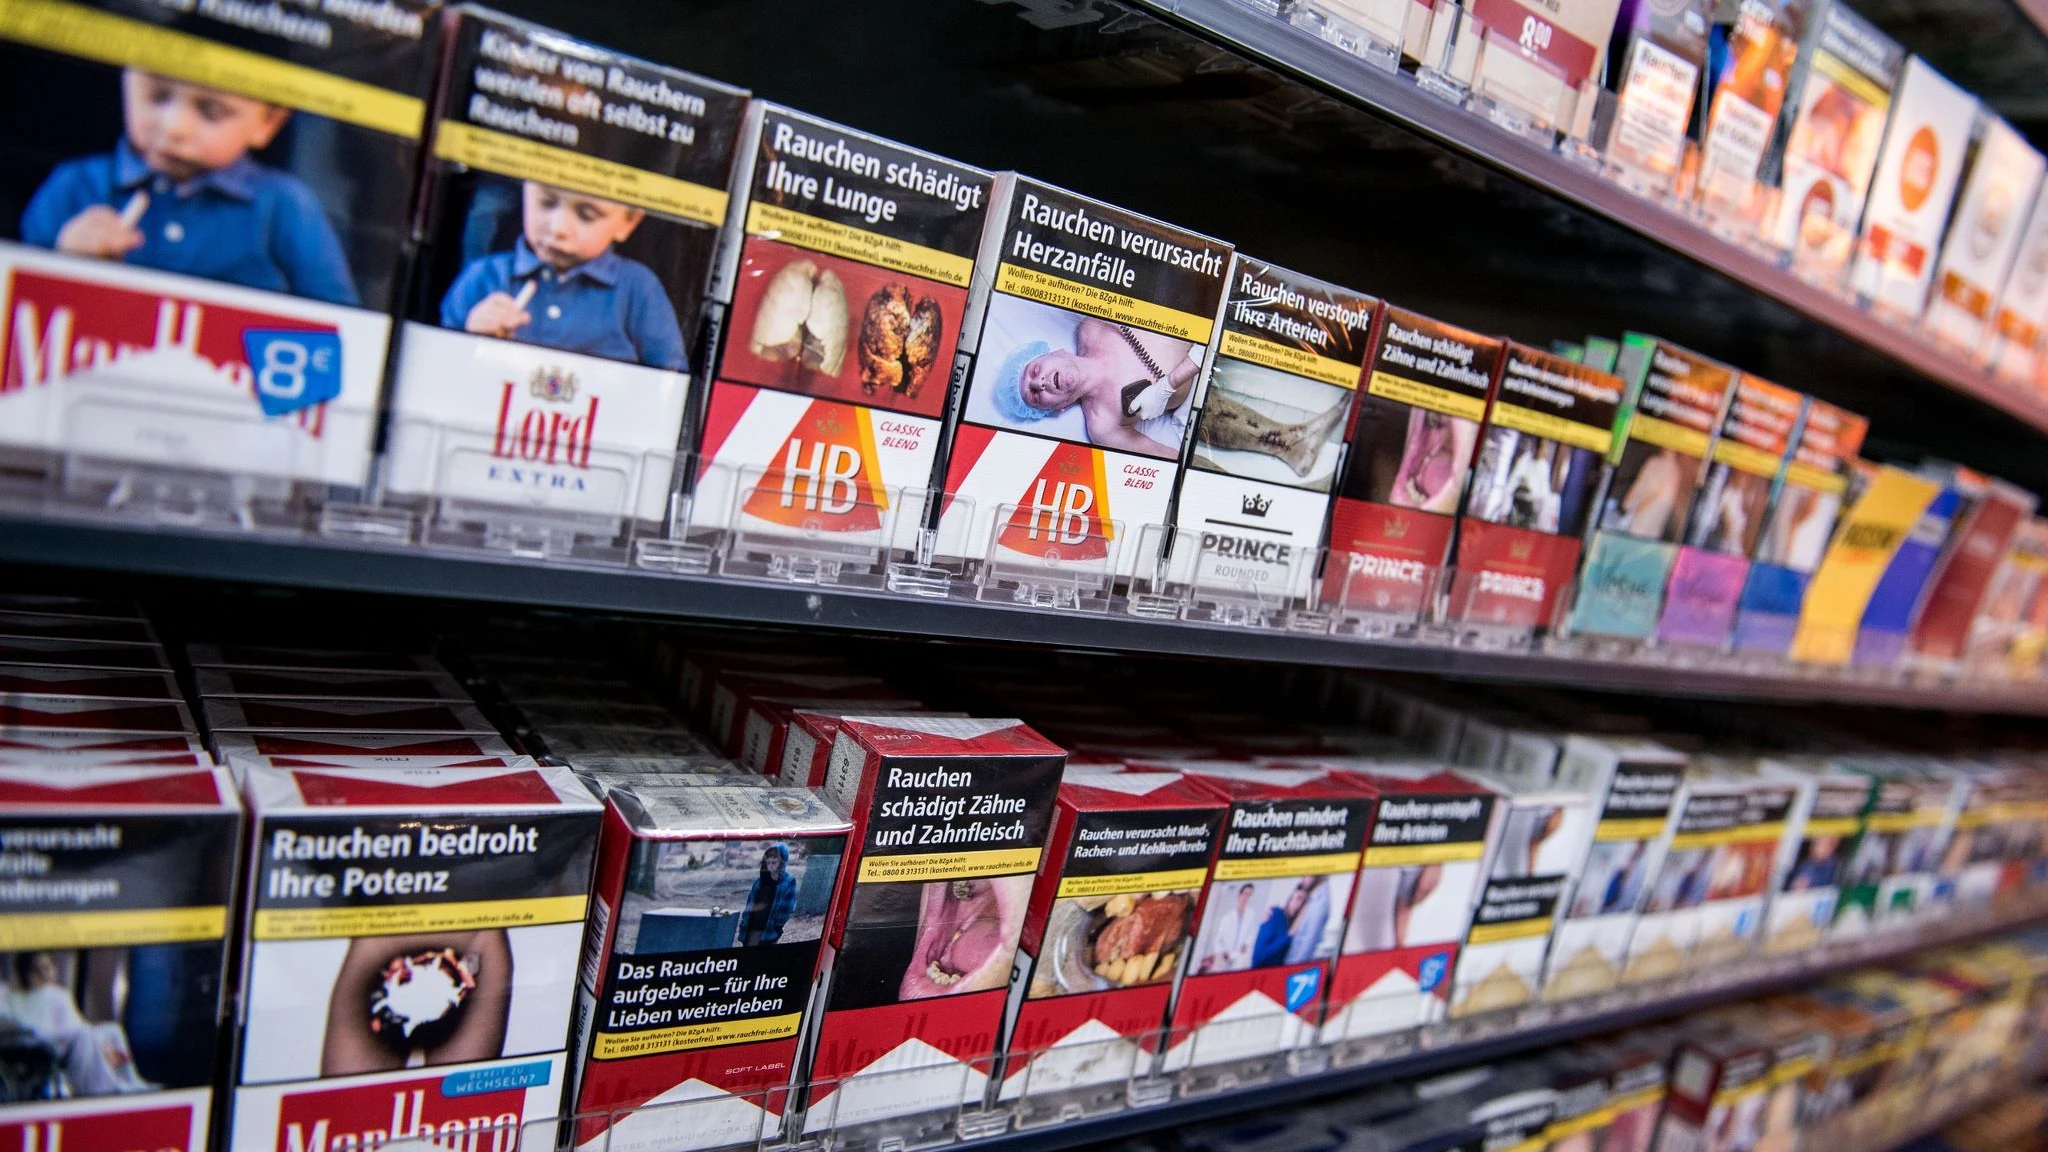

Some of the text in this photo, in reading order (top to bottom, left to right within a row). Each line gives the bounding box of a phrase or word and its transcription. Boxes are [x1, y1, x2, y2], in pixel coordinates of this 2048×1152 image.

[562, 58, 604, 88] von
[607, 68, 706, 116] Rauchern
[469, 94, 579, 145] Rauchern
[474, 66, 696, 145] werden oft selbst zu
[774, 123, 881, 179] Rauchen
[886, 162, 983, 211] schädigt
[766, 161, 897, 223] Ihre Lunge
[1021, 193, 1223, 278] Rauchen verursacht
[882, 256, 963, 282] www.rauchfrei-info.de
[1012, 231, 1136, 288] Herzanfälle
[1007, 266, 1135, 308] Wollen Sie aufhören? Die BZgA hilft:
[1240, 272, 1370, 331] Rauchen verstopft
[1004, 280, 1189, 337] Tel.: 08008313131 (kostenfrei), www.rauchfrei-info.de
[1234, 301, 1328, 347] Ihre Arterien
[1387, 322, 1474, 366] Rauchen schädigt
[1381, 343, 1415, 367] Zähne
[1415, 353, 1436, 372] und
[1436, 359, 1490, 389] Zahnfleisch
[491, 380, 599, 470] Lord
[880, 421, 926, 437] CLASSIC
[882, 437, 919, 451] BLEND
[488, 467, 587, 491] EXTRA
[780, 438, 861, 514] HB
[1123, 464, 1159, 478] CLASSIC
[1125, 478, 1153, 490] BLEND
[1029, 478, 1094, 545] HB
[1201, 532, 1291, 567] PRINCE
[1214, 564, 1270, 582] ROUNDED
[1349, 551, 1425, 583] PRINCE
[887, 766, 972, 788] Rauchen
[881, 795, 1026, 820] schädigt Zähne
[1232, 806, 1348, 828] Rauchen mindert
[272, 824, 538, 861] Rauchen bedroht
[876, 820, 1024, 846] und Zahnfleisch
[1079, 823, 1211, 841] Rauchen verursacht Mund-,
[1225, 830, 1347, 853] Ihre Fruchtbarkeit
[869, 859, 889, 867] Wollen
[900, 858, 928, 866] aufhören?
[939, 857, 953, 865] BZgA
[954, 856, 967, 864] hilft:
[1074, 840, 1207, 858] Rachen- und Kehlkopfkrebs
[269, 867, 449, 899] Ihre Potenz
[867, 869, 880, 877] Tel.:
[906, 867, 928, 875] 313131
[930, 864, 967, 875] (kostenfrei),
[968, 861, 1033, 872] www.rauchfrei-info.de
[618, 956, 738, 980] Das Rauchen
[613, 981, 704, 1006] aufgeben
[724, 976, 751, 995] für
[754, 974, 788, 992] Ihre
[608, 997, 783, 1028] Lieben weiterleben
[603, 1025, 792, 1055] Tel.: 0800 8 313131 (kostenfrei), www.rauchfrei-info.de
[605, 1024, 722, 1046] Wollen Sie aufhören? Die BZgA hilft:
[456, 1074, 535, 1093] WECHSELN?
[725, 1062, 787, 1075] SOFT LABEL
